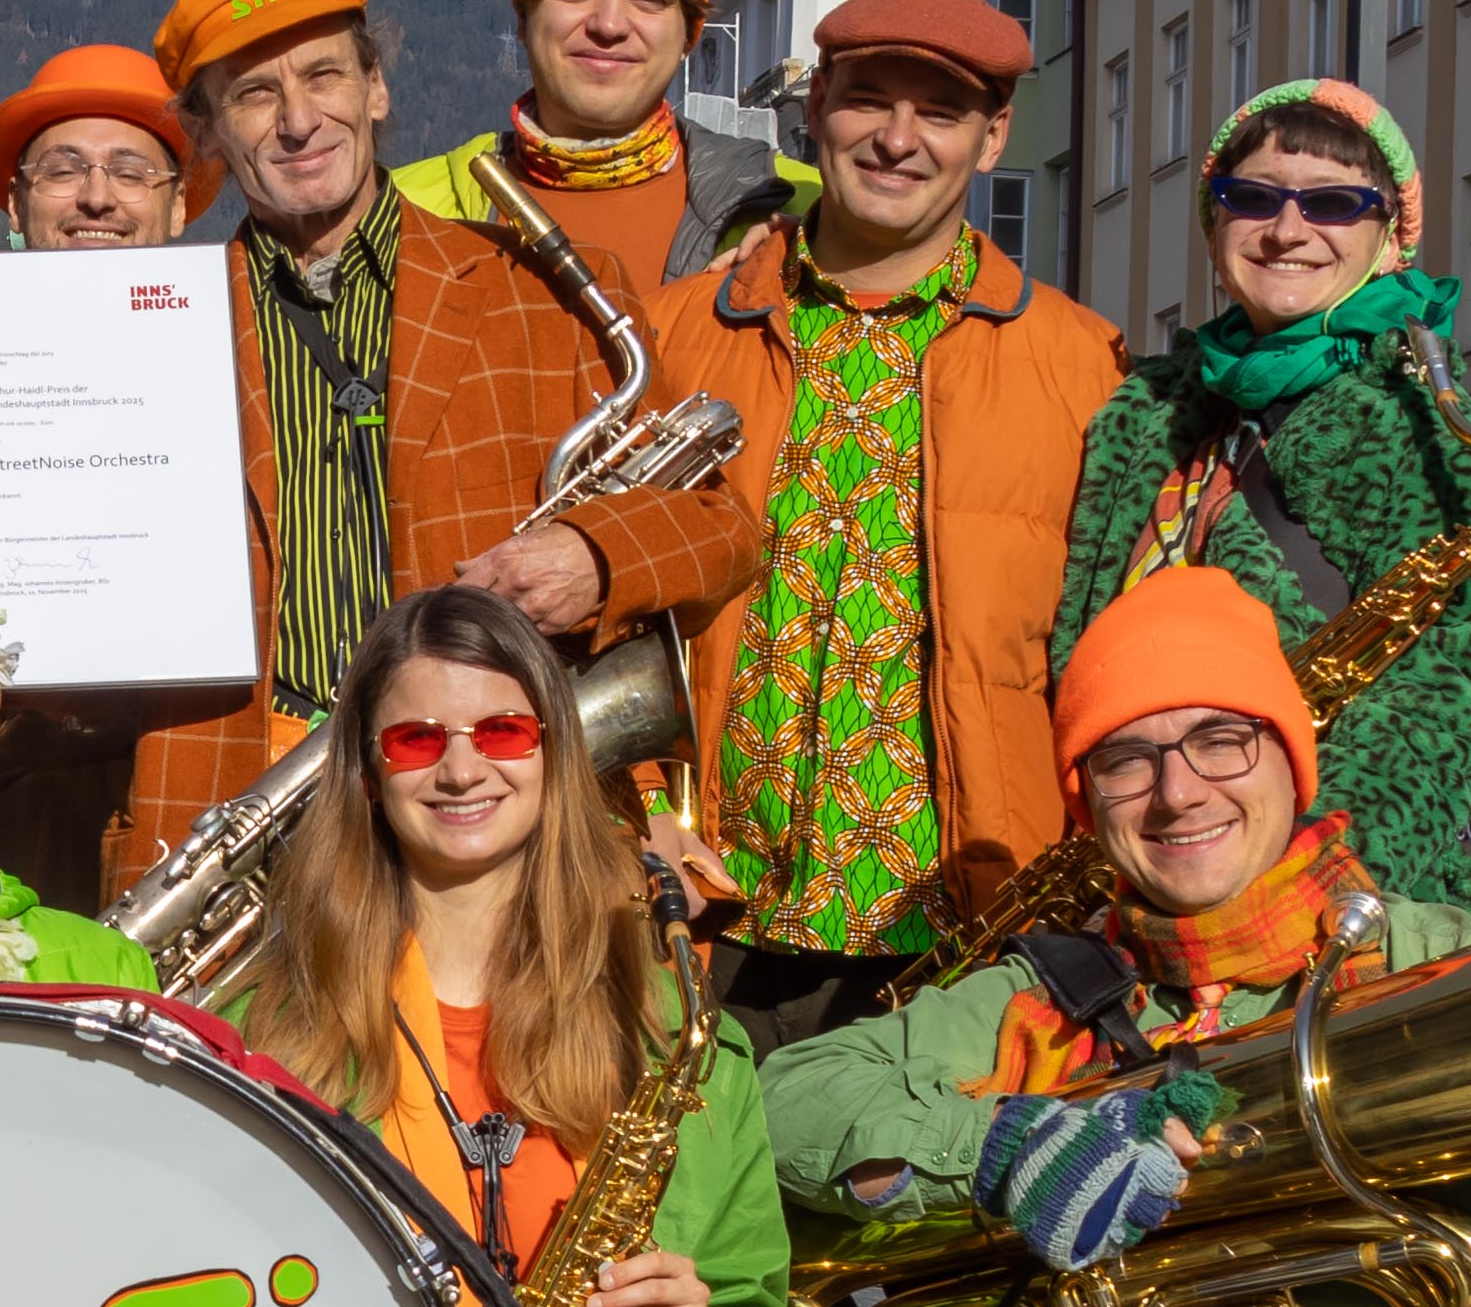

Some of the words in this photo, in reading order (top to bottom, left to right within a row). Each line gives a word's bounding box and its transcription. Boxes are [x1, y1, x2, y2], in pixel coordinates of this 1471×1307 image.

[130, 284, 175, 298] INNS'
[131, 296, 190, 311] BRUCK
[72, 384, 89, 393] der
[72, 397, 119, 407] Innsbruck
[121, 397, 145, 406] 2025
[89, 453, 170, 468] Orchestra
